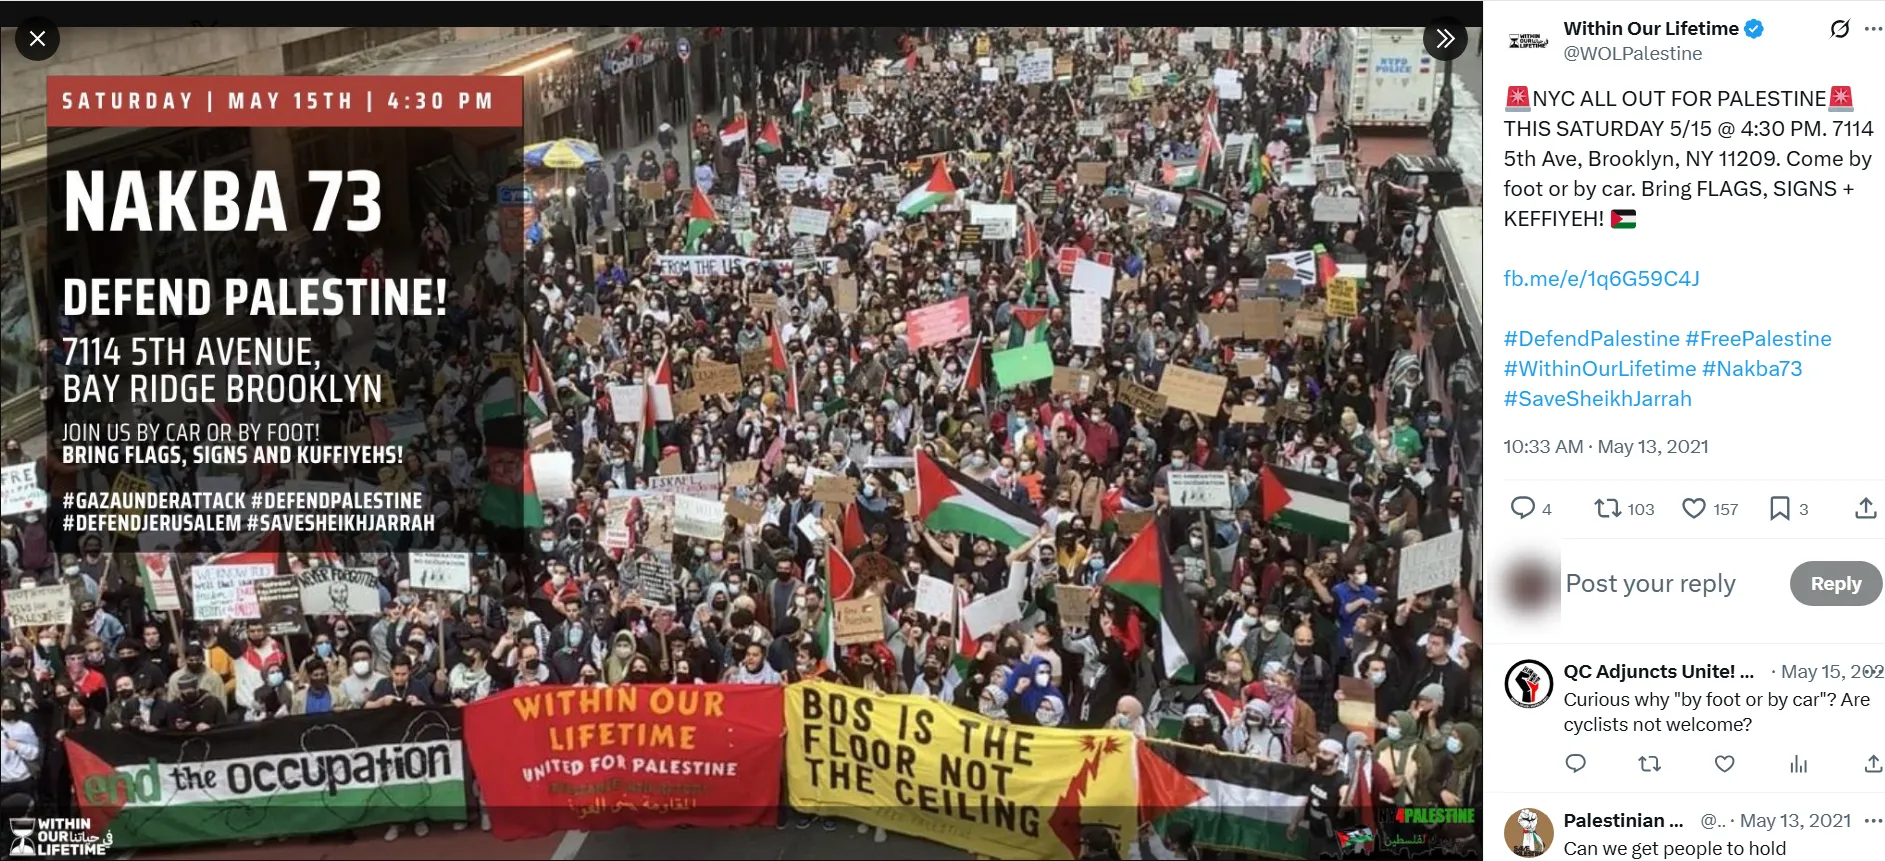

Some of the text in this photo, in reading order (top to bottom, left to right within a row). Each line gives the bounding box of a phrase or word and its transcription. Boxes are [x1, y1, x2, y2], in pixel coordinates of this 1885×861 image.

[1564, 21, 1739, 35] Within Our Lifetime
[1380, 57, 1408, 65] NYPD
[1564, 46, 1702, 61] @WOLPalestine
[1375, 65, 1412, 73] POLICE
[1534, 91, 1826, 106] NYC ALL OUT FOR PALESTINE
[1504, 120, 1874, 138] THIS SATURDAY 5/15 @ 4:30 PM. 7114
[1505, 150, 1872, 170] 5th Ave, Brooklyn, NY 11209. Come by
[1504, 180, 1854, 200] foot or by car. Bring FLAGS, SIGNS +
[1505, 211, 1603, 226] KEFFIYEH!
[660, 260, 690, 275] FROM
[695, 261, 716, 274] THE
[1504, 270, 1698, 290] fb.me/e/1q6G59C4J
[1504, 330, 1831, 346] #DefendPalestine #FreePalestine
[1504, 360, 1802, 376] #WithinOurLifetime #Nakba73
[1504, 390, 1691, 406] #SaveSheikhJarrah
[1504, 440, 1582, 453] 10:33 AM
[1599, 440, 1707, 457] May 13, 2021
[1542, 504, 1552, 515] 4
[1628, 504, 1654, 515] 103
[1714, 504, 1738, 515] 157
[1800, 504, 1808, 515] 3
[1568, 573, 1736, 597] Post your reply
[1812, 576, 1862, 594] Reply
[1564, 664, 1734, 682] QC Adjuncts Unite!
[1783, 665, 1884, 682] May 15, 202
[512, 687, 726, 722] WITHIN OUR
[1564, 692, 1629, 706] Curious
[1635, 692, 1669, 710] why
[1675, 692, 1702, 710] "by
[1706, 692, 1740, 706] foot
[1746, 696, 1763, 706] or
[1769, 692, 1788, 710] by
[1793, 692, 1836, 706] car"?
[1841, 693, 1870, 706] Are
[802, 688, 1036, 767] BDS IS THE
[1564, 717, 1752, 735] cyclists not welcome?
[547, 722, 698, 752] LIFETIME
[522, 754, 739, 783] UNITED FOR PALESTINE
[803, 725, 1014, 797] FLOOR NOT
[83, 758, 162, 804] end
[169, 767, 217, 791] the
[805, 756, 1040, 838] THE CEILING
[1565, 813, 1664, 827] Palestinian
[1741, 814, 1850, 831] May 13, 2021
[1564, 841, 1785, 859] Can we get people to hold
